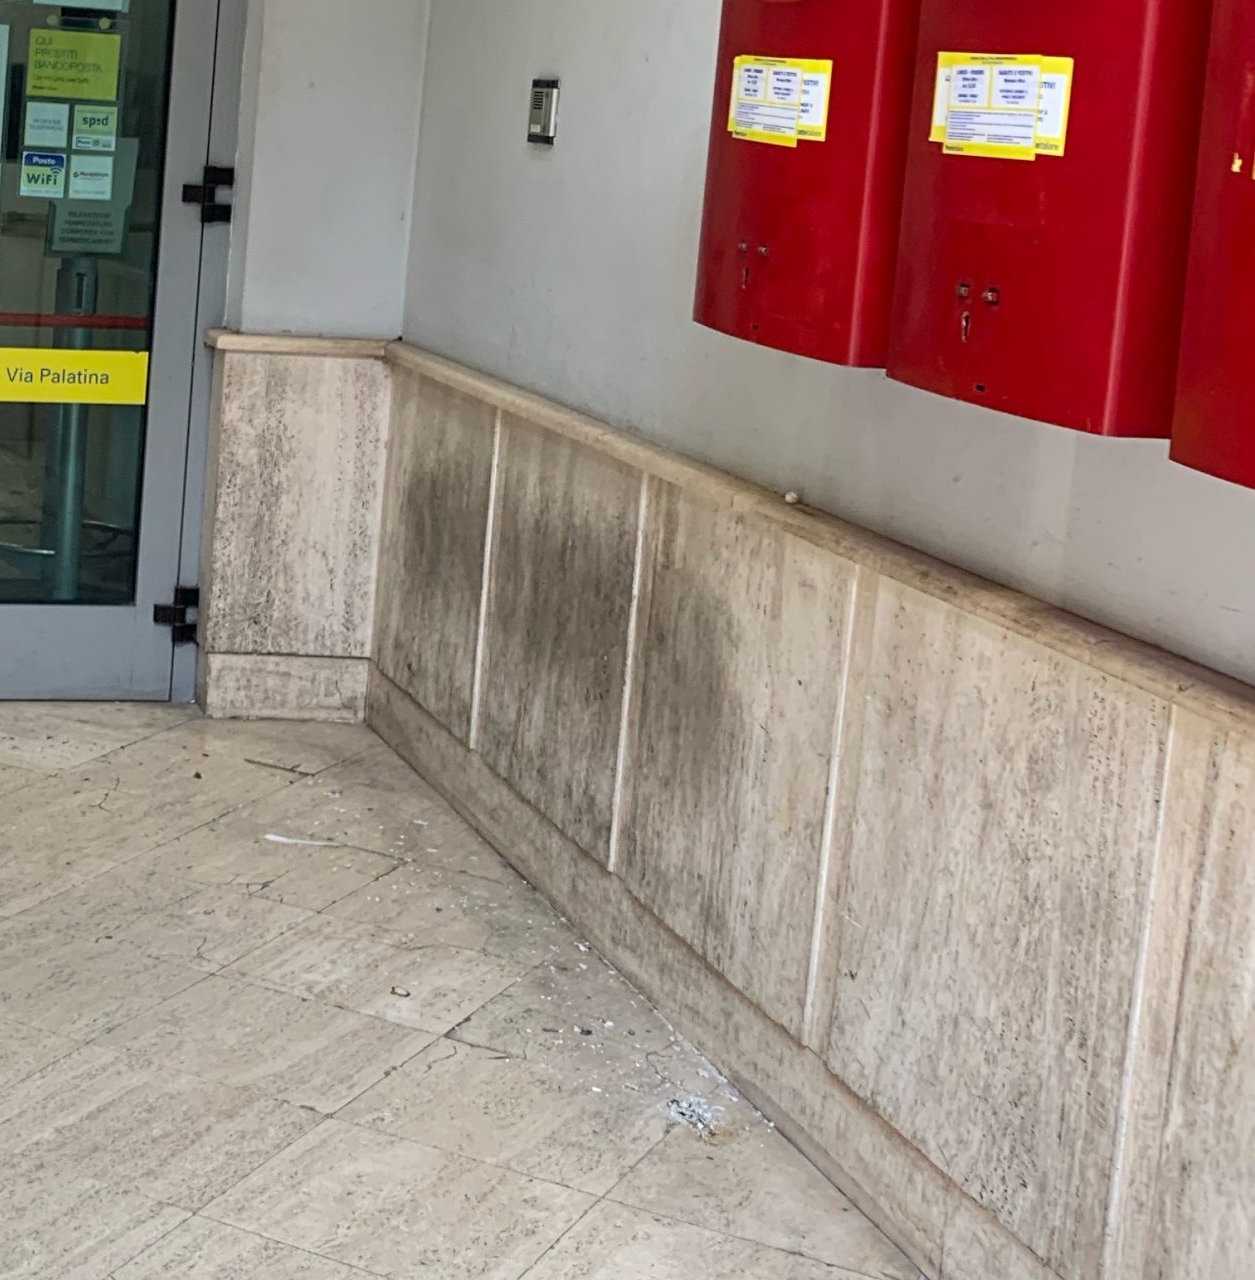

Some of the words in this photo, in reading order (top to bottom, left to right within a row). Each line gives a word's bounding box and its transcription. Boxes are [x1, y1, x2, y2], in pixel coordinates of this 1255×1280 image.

[32, 156, 56, 165] Poste
[26, 173, 57, 186] WiFi
[6, 368, 34, 384] Via
[40, 368, 110, 385] Palatina
